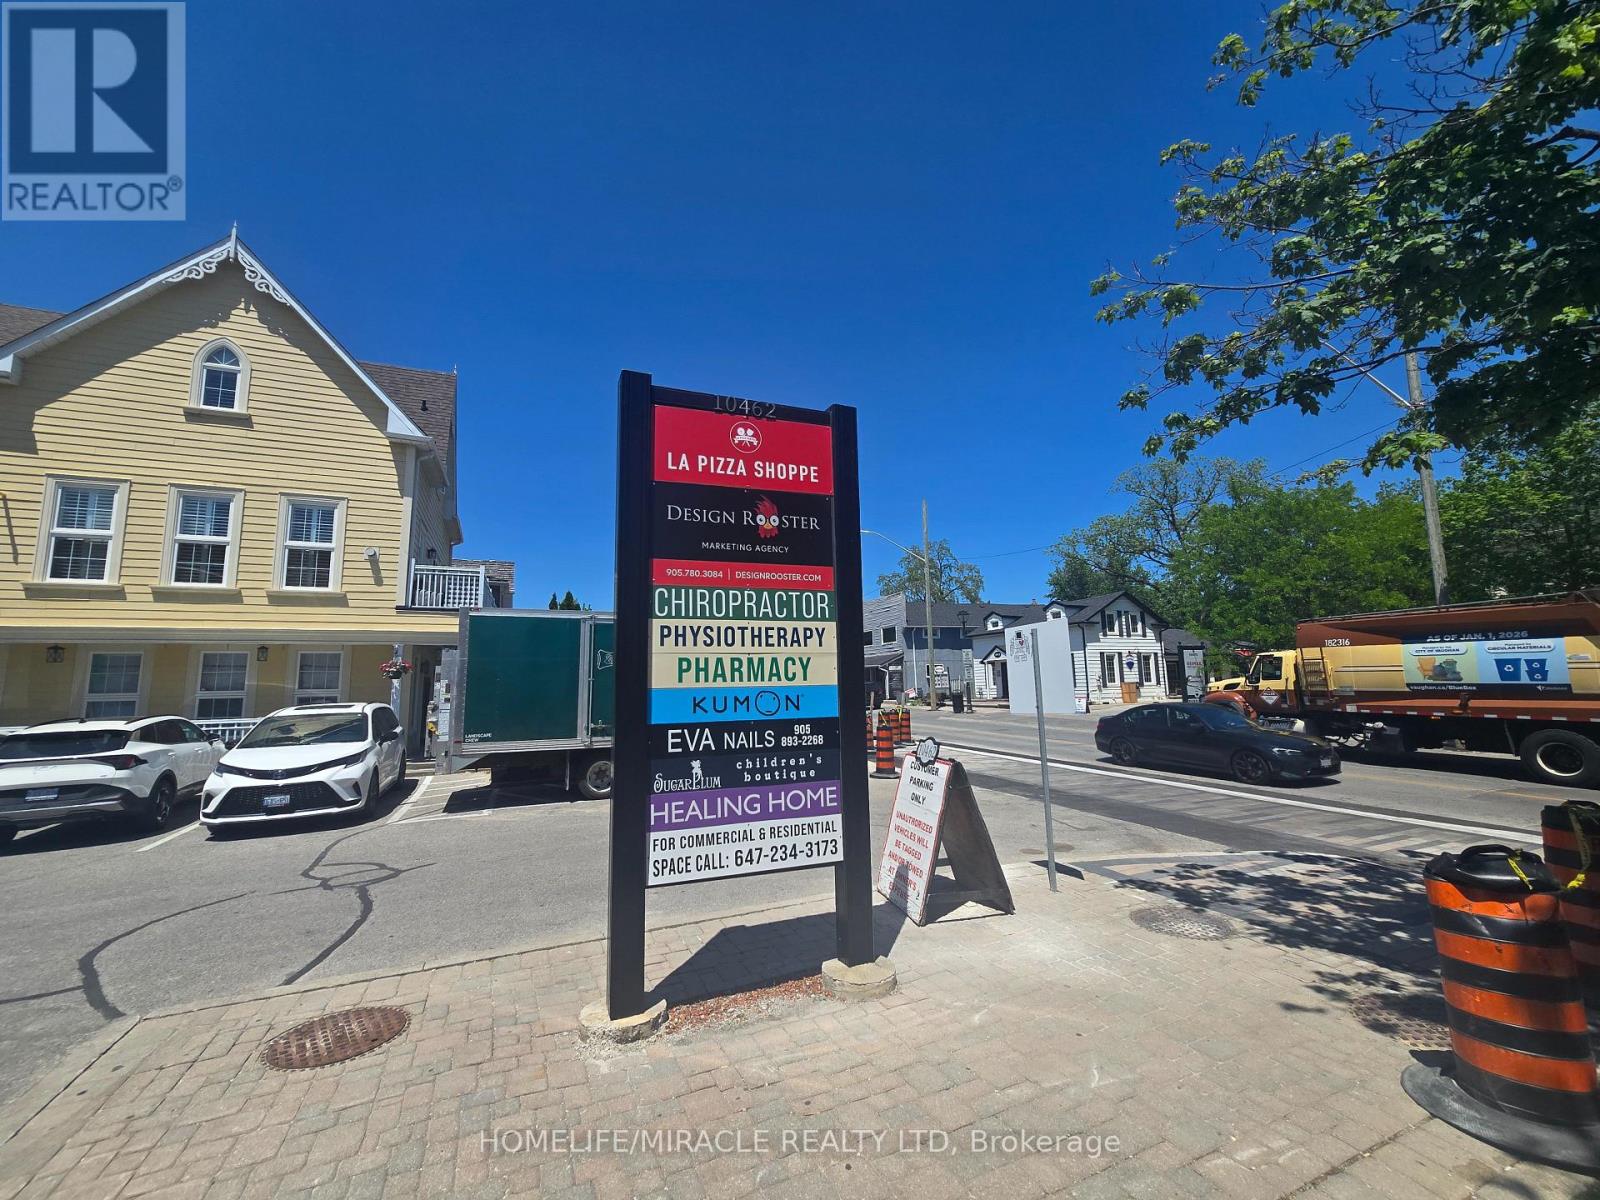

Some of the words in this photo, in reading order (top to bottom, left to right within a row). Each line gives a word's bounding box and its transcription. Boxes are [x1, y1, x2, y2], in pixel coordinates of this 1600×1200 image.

[714, 394, 776, 418] 10462
[667, 452, 690, 471] LA
[698, 455, 747, 476] PIZZA
[754, 461, 819, 483] SHOPPE
[667, 504, 735, 525] DESIGN
[701, 541, 752, 552] MARKETING
[755, 544, 789, 554] AGENCY
[666, 568, 723, 578] 905.780.3084
[735, 571, 822, 582] DESIGNROOSTER.COM
[654, 587, 830, 618] CHIROPRACTOR
[659, 625, 826, 647] PHYSIOTHERAPY
[1324, 638, 1350, 647] 182316
[1459, 632, 1486, 640] JAN.
[1499, 630, 1528, 639] 2026
[677, 656, 812, 683] PHARMACY
[692, 691, 801, 716] KUMON
[794, 724, 811, 735] 905
[667, 728, 716, 753] EVA
[724, 730, 775, 750] NAILS
[781, 735, 824, 747] 893-2268
[736, 753, 823, 770] children's
[744, 769, 816, 782] boutique
[909, 775, 934, 791] PARKING
[650, 793, 761, 826] HEALING
[768, 786, 838, 814] HOME
[911, 793, 926, 805] ONLY
[896, 811, 933, 834] UNAUTHORIZED
[652, 837, 676, 852] FOR
[680, 828, 756, 850] COMMERCIAL
[759, 827, 766, 840] &
[770, 820, 838, 839] RESIDENTIAL
[894, 824, 916, 842] VEHICLES
[917, 834, 929, 849] WILL
[652, 856, 692, 878] SPACE
[695, 853, 730, 872] CALL:
[734, 838, 838, 867] 647-234-3173
[895, 838, 902, 849] BE
[902, 842, 922, 861] TAGGED
[888, 865, 896, 876] AT
[906, 858, 924, 879] TOWED
